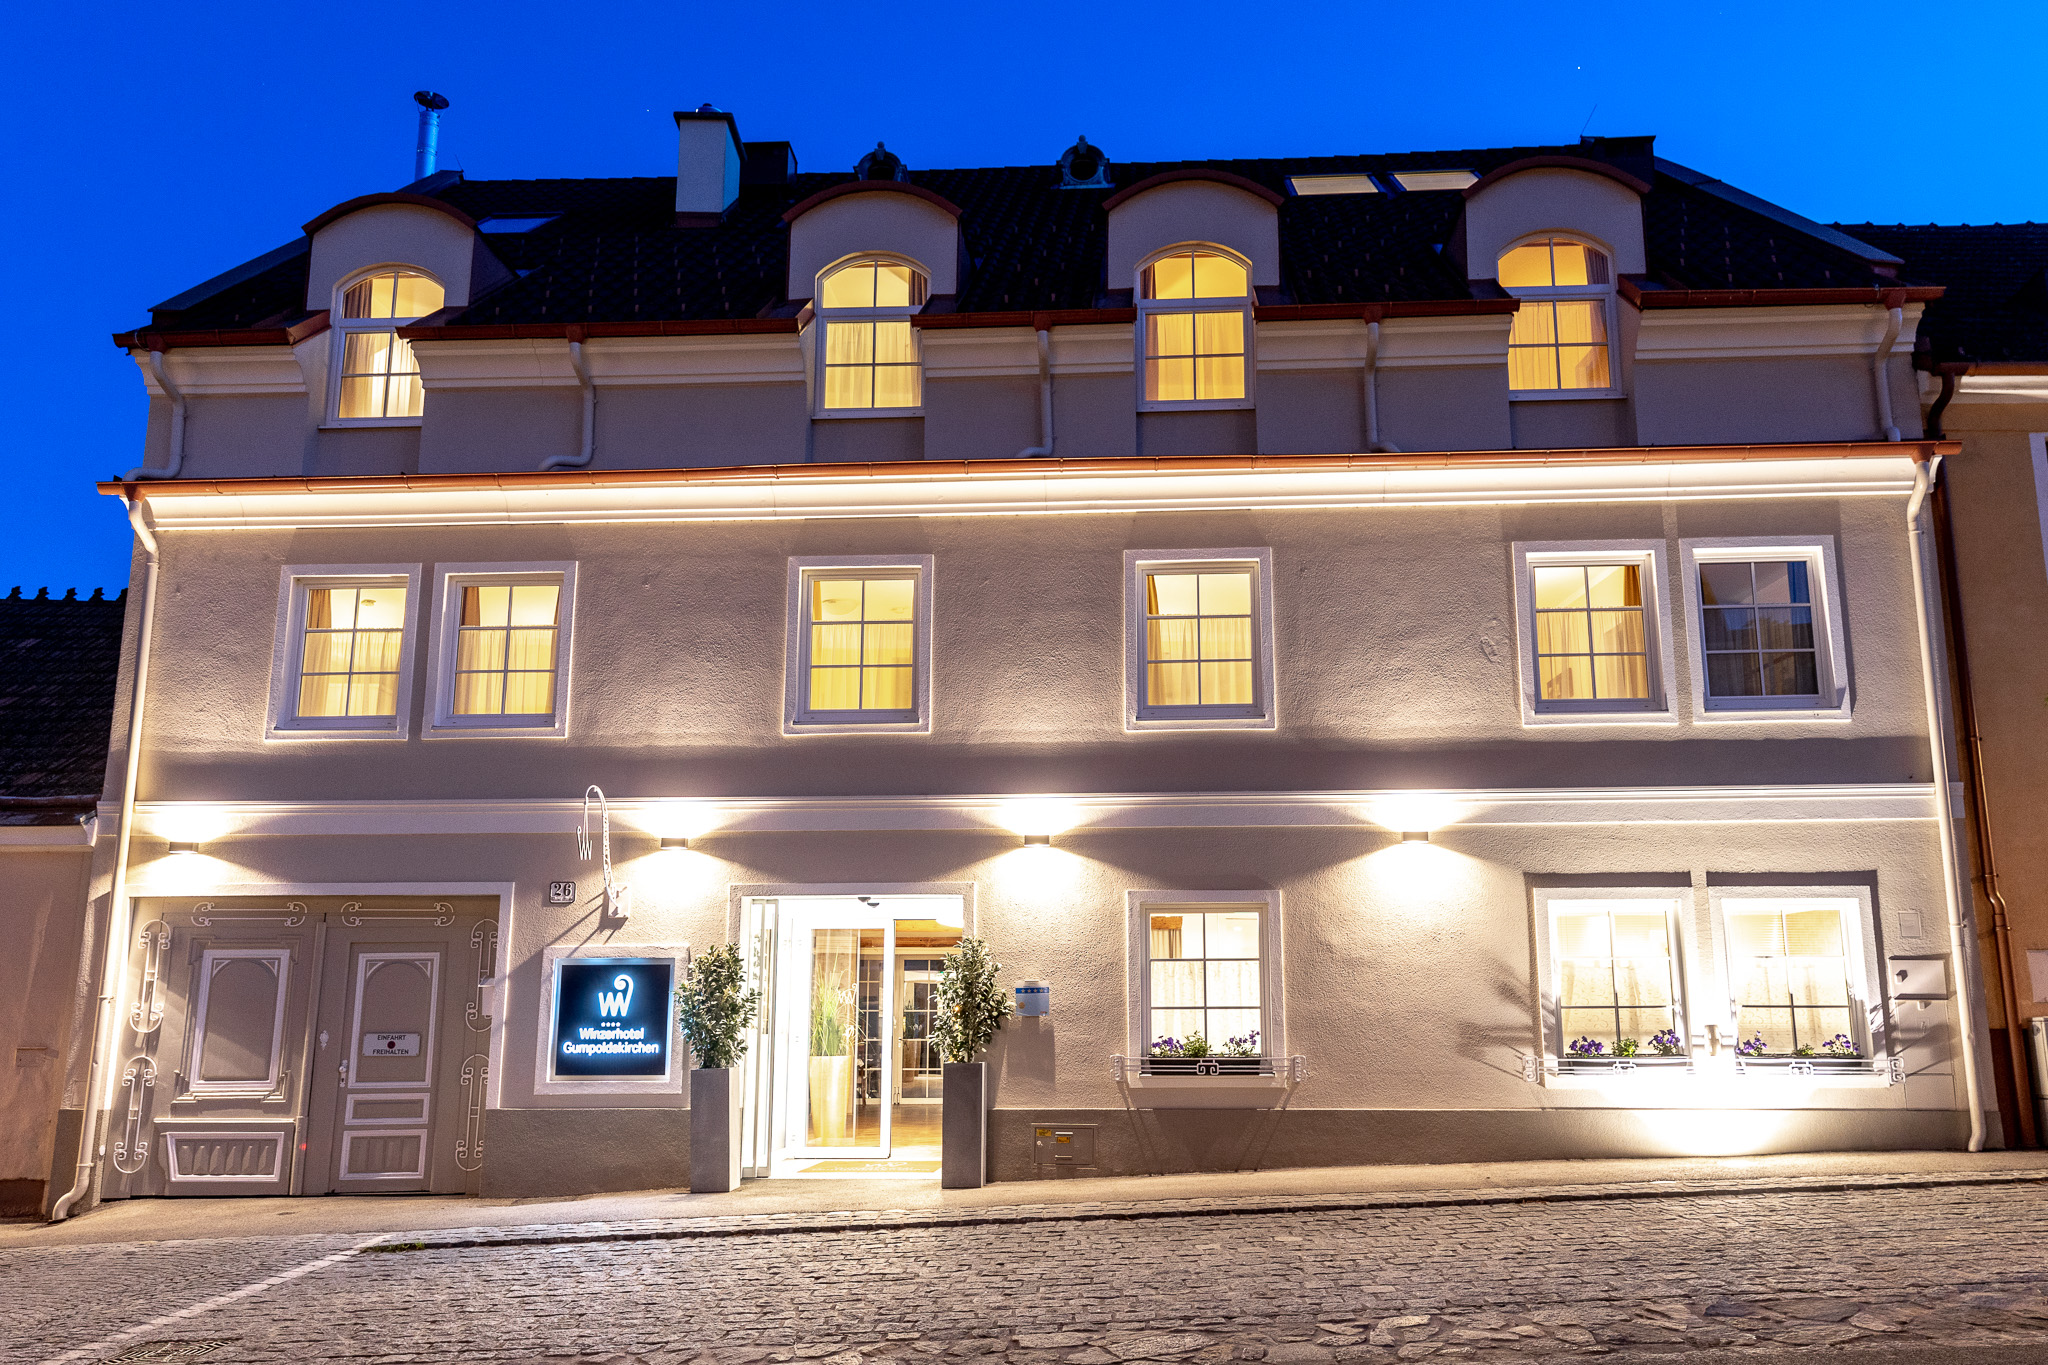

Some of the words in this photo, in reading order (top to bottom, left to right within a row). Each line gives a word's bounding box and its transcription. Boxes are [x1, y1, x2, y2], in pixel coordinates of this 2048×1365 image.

[554, 883, 572, 896] 26
[579, 1027, 645, 1040] Winzerhotel
[563, 1041, 660, 1057] Gumpoldskirchen
